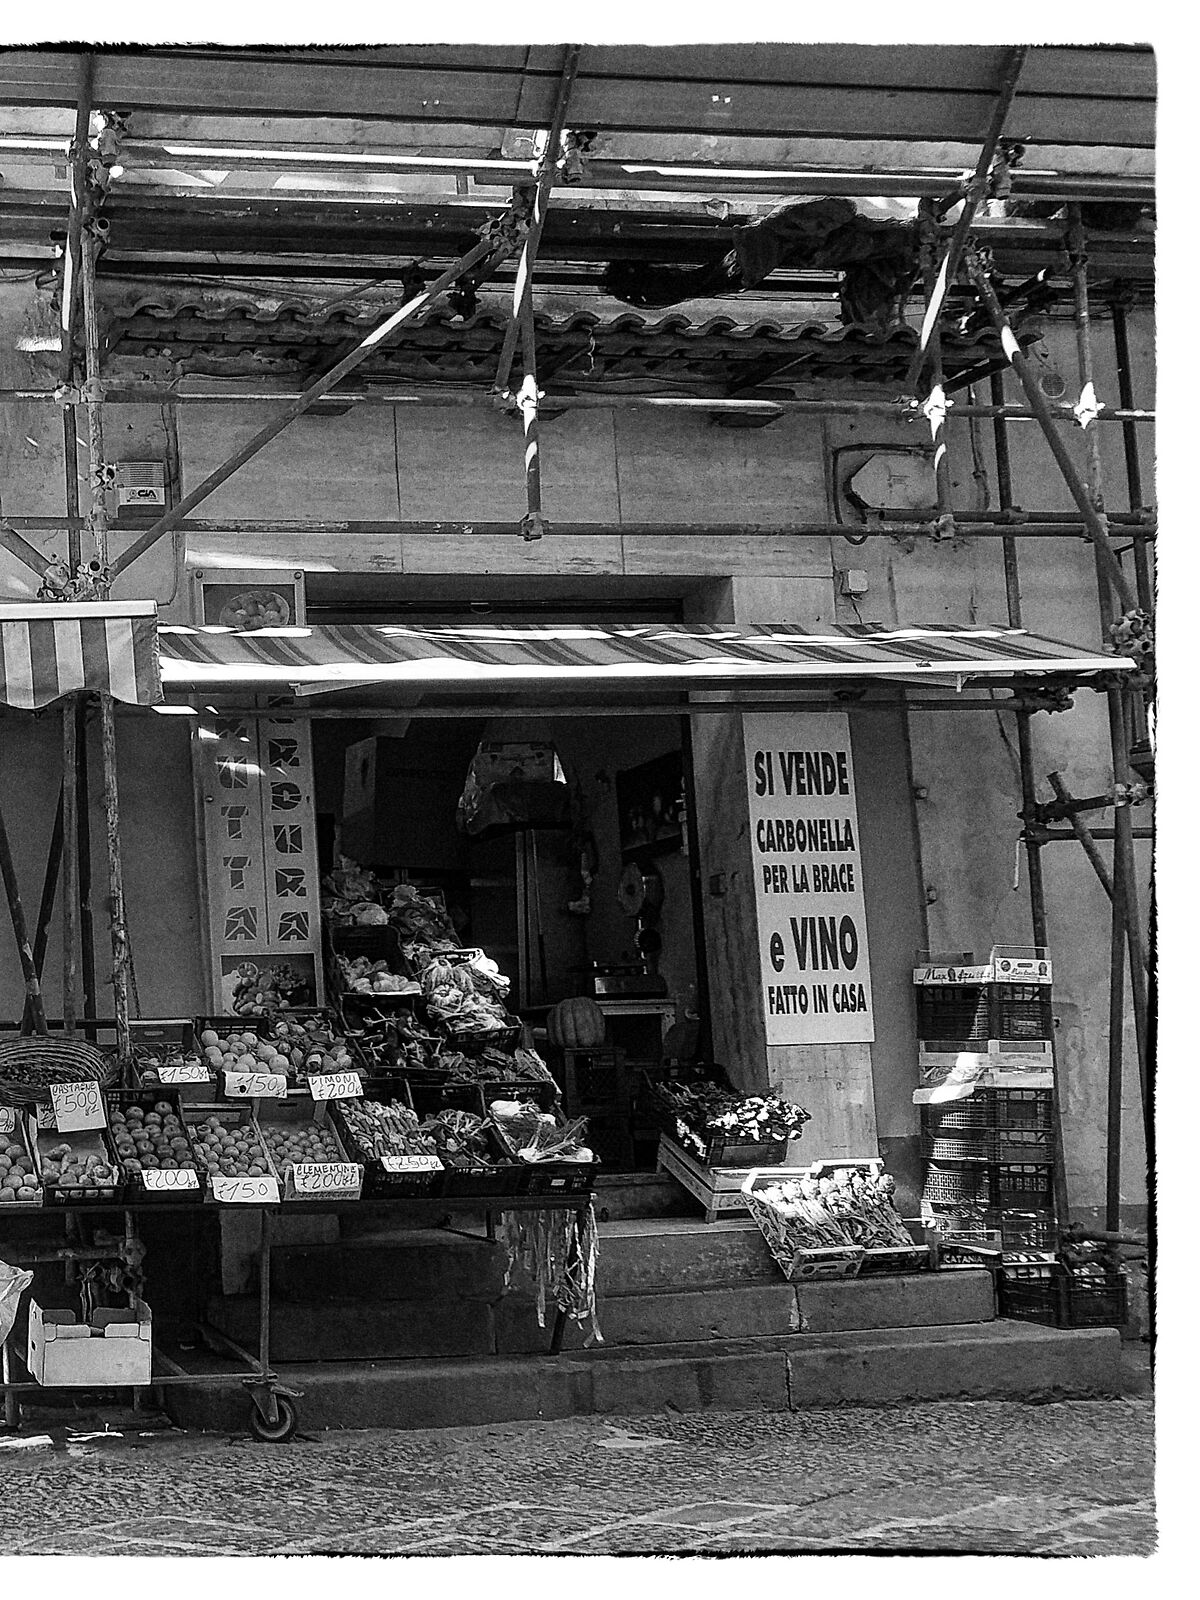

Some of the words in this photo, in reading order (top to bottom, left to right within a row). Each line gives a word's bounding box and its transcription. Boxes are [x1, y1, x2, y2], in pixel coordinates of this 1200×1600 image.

[754, 750, 775, 797] SI
[778, 751, 850, 796] VENDE
[214, 718, 258, 941] RUTTA
[756, 818, 856, 853] CARBONELLA
[762, 864, 790, 894] PER
[791, 864, 811, 893] LA
[812, 863, 855, 893] BRACE
[769, 931, 786, 973] e
[789, 914, 859, 971] VINO
[767, 984, 809, 1015] FATTO
[812, 984, 829, 1013] IN
[832, 983, 868, 1013] CASA
[51, 1081, 97, 1096] CASTAGNE
[310, 1075, 358, 1087] LIMONI
[296, 1163, 357, 1176] CLEMENTINE
